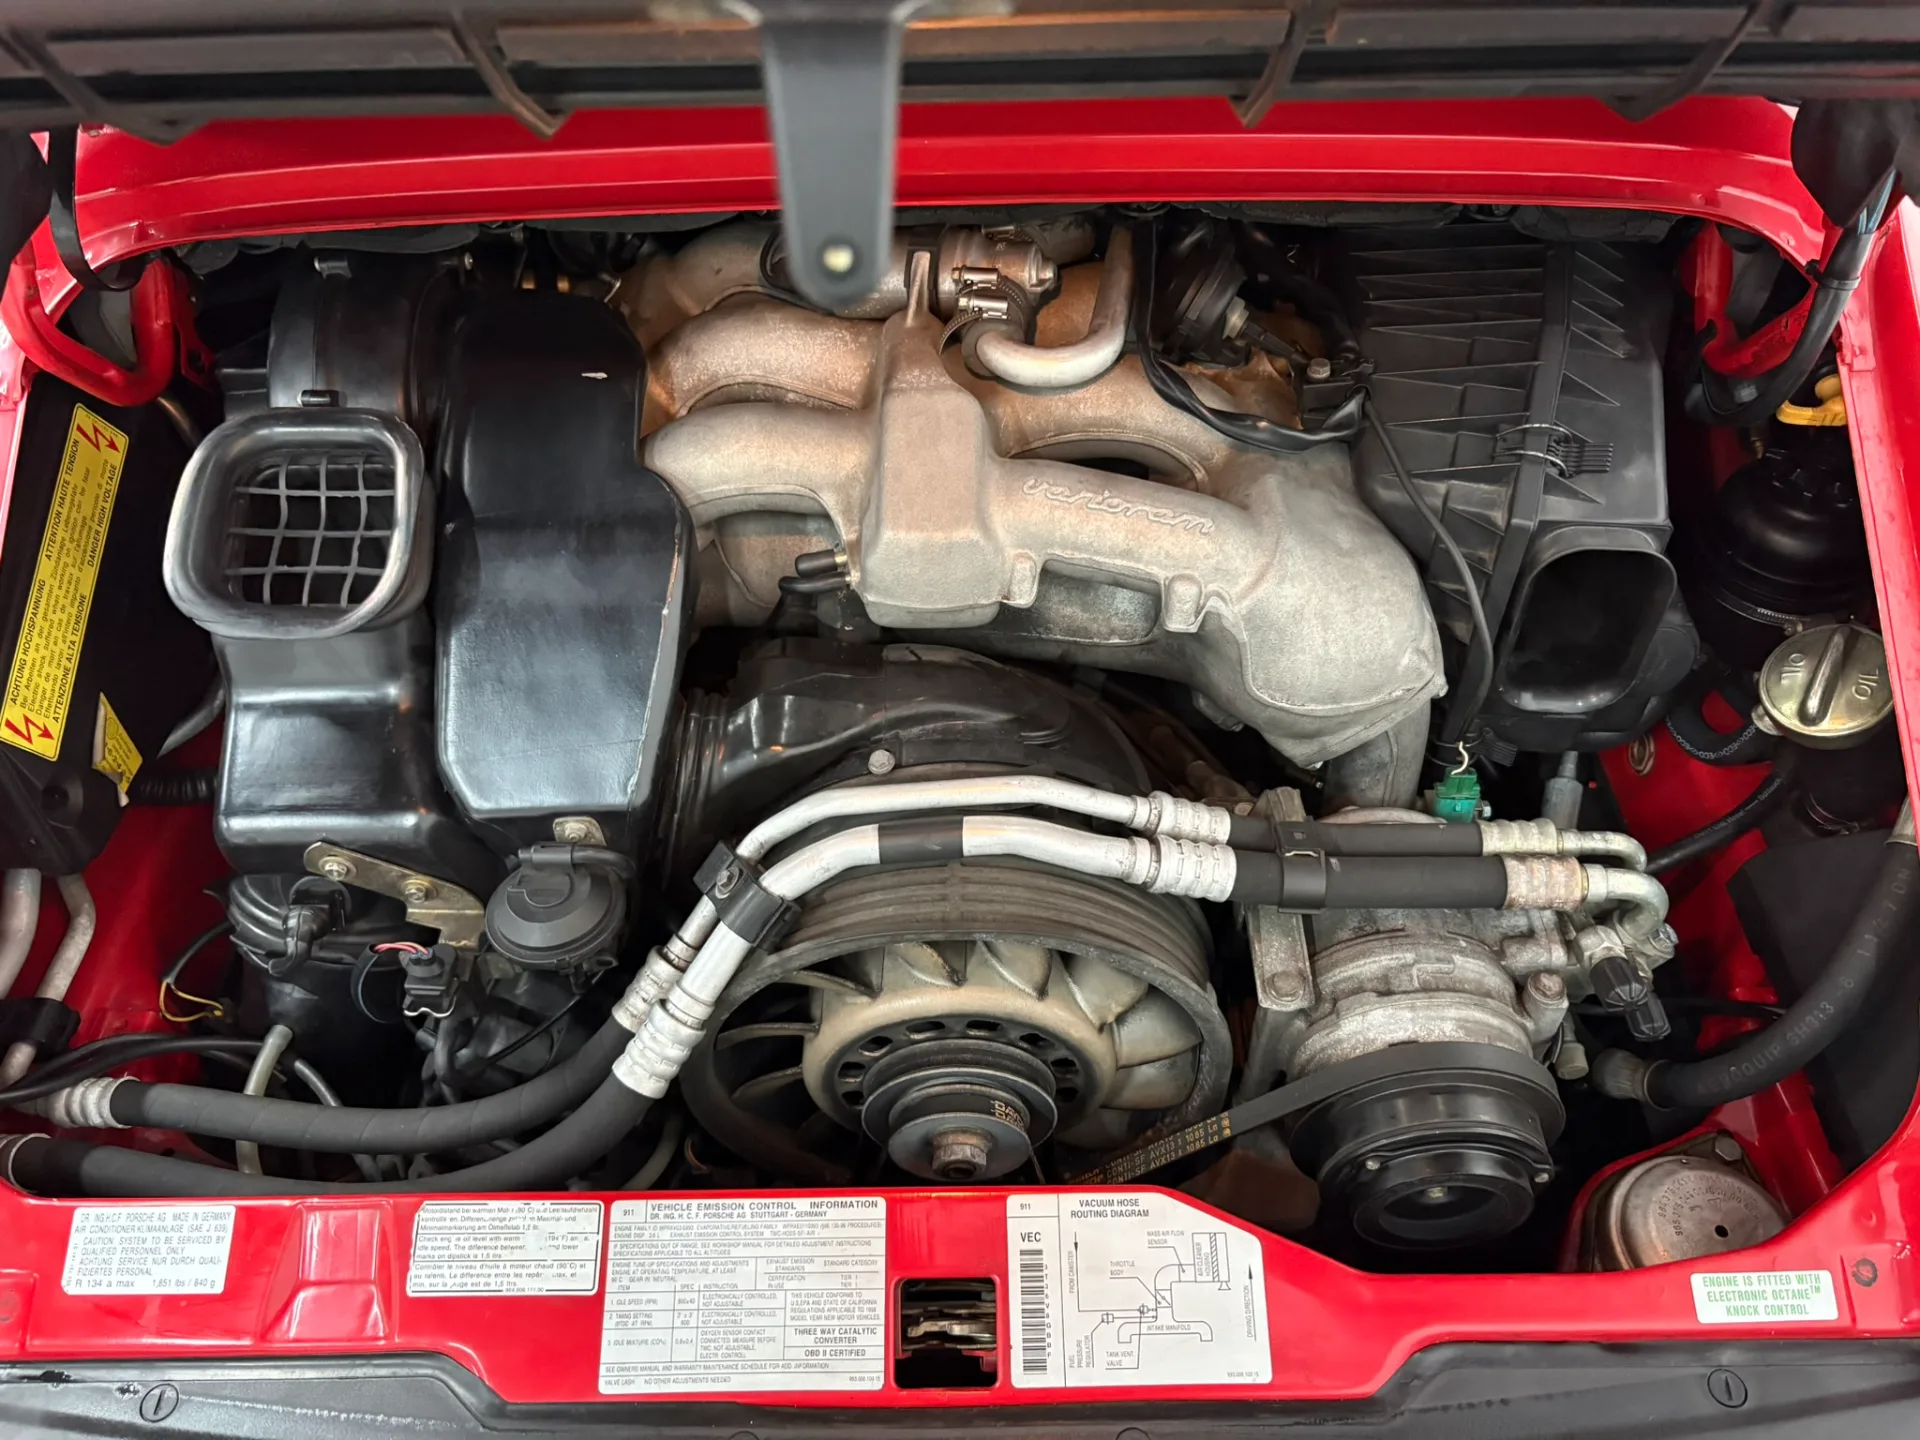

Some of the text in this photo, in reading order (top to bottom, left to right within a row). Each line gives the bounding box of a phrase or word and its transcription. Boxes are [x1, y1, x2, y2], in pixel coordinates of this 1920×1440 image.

[46, 439, 79, 561] ATTENTION HAUTE TENSION
[1022, 476, 1214, 536] varioram
[87, 464, 117, 568] DANGER HIGH VOLTAGE
[25, 658, 37, 691] Arbeiten
[34, 643, 41, 654] an
[42, 584, 54, 622] gesamten
[28, 683, 40, 713] Electric
[37, 656, 46, 679] shock
[44, 619, 54, 651] suffered
[52, 594, 60, 615] when
[58, 562, 69, 591] working
[66, 548, 71, 558] on
[10, 579, 46, 705] ACHTUNG HOCHSPANNUNG
[36, 687, 47, 716] Danger
[44, 672, 51, 683] de
[48, 650, 56, 668] mort
[53, 636, 59, 647] en
[60, 604, 66, 614] de
[63, 573, 74, 600] travaux
[44, 674, 59, 719] Effettuando
[70, 577, 81, 609] impianto
[53, 594, 87, 723] ATTENZIONE ALTA TENSIONE
[1780, 652, 1805, 686] OIL
[1852, 668, 1880, 700] OIL
[1150, 1141, 1175, 1159] AVX13
[1186, 1128, 1204, 1142] 1085
[1187, 1139, 1205, 1152] 1085
[651, 1200, 877, 1211] VEHICLE EMISSION CONTROL INFORMATION
[1079, 1198, 1139, 1207] VACUUM HOSE
[202, 1212, 231, 1221] GERMANY
[1070, 1209, 1149, 1218] ROUTING DIAGRAM
[206, 1224, 211, 1232] J
[119, 1236, 225, 1245] SYSTEM TO BE SERVICED BY
[1020, 1232, 1041, 1242] VEC
[81, 1246, 185, 1256] QUALIFIED PERSONNEL ONLY
[118, 1257, 148, 1266] SERVICE
[152, 1257, 167, 1265] NUR
[170, 1257, 195, 1265] DURCH
[77, 1267, 152, 1276] FIZIERTES PERSONAL
[87, 1279, 102, 1288] 134
[210, 1280, 216, 1288] g
[1702, 1273, 1821, 1288] ENGINE IS FITTED WITH
[1707, 1290, 1768, 1303] ELECTRONIC
[1726, 1303, 1809, 1317] KNOCK CONTROL
